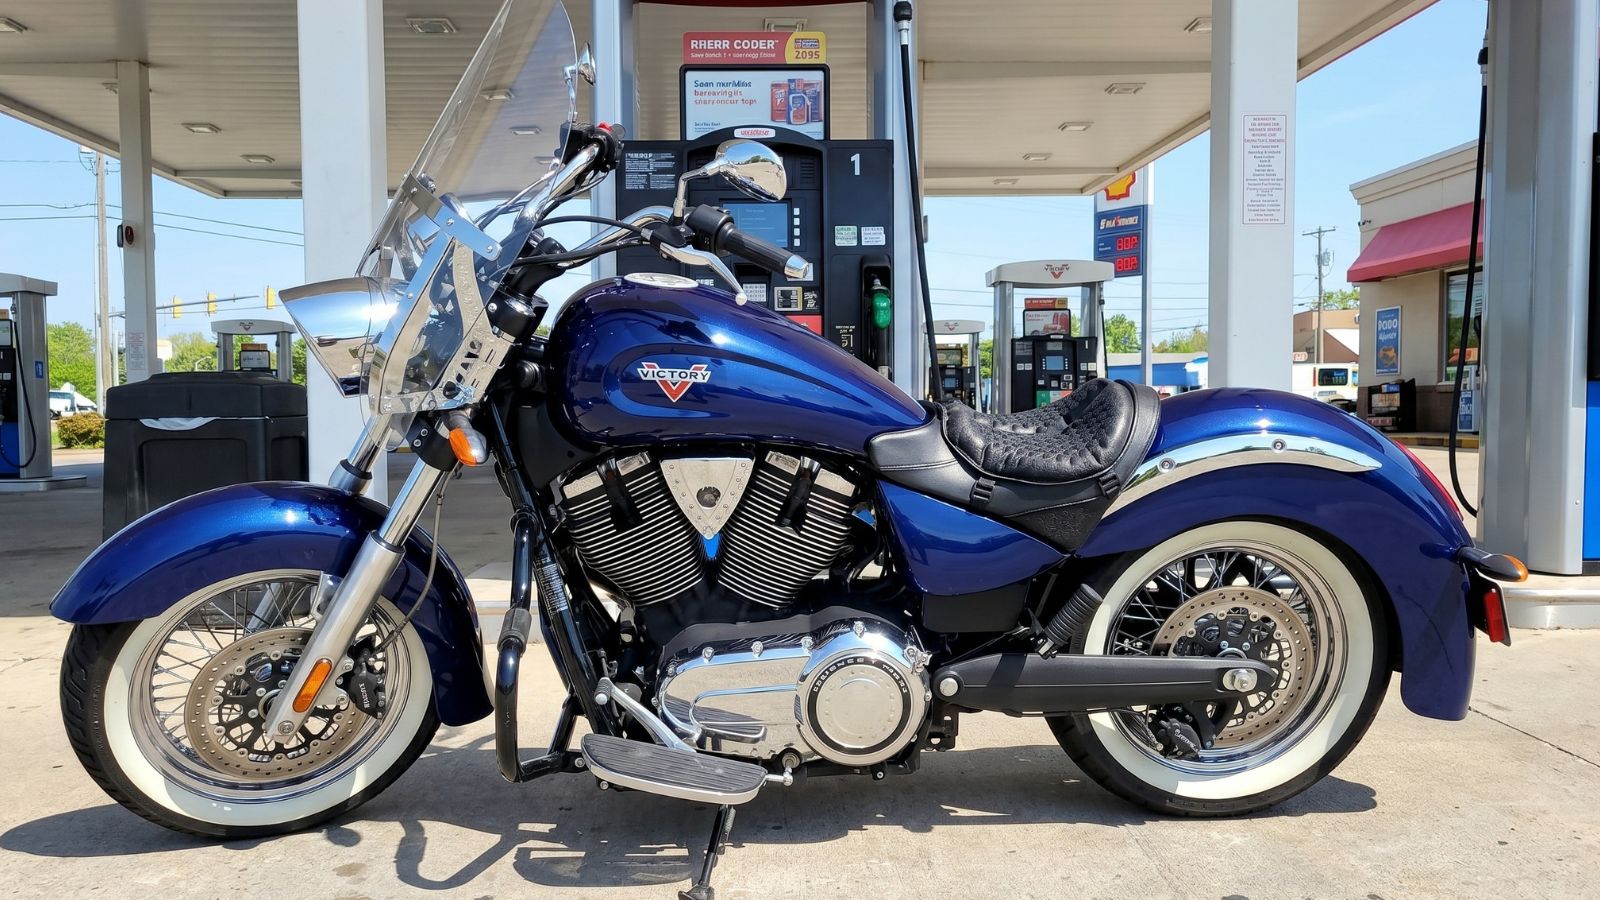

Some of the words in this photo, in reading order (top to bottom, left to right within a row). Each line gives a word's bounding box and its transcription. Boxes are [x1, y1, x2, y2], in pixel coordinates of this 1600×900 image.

[795, 50, 820, 60] 2095
[850, 153, 860, 176] 1
[640, 369, 709, 381] VICTORY
